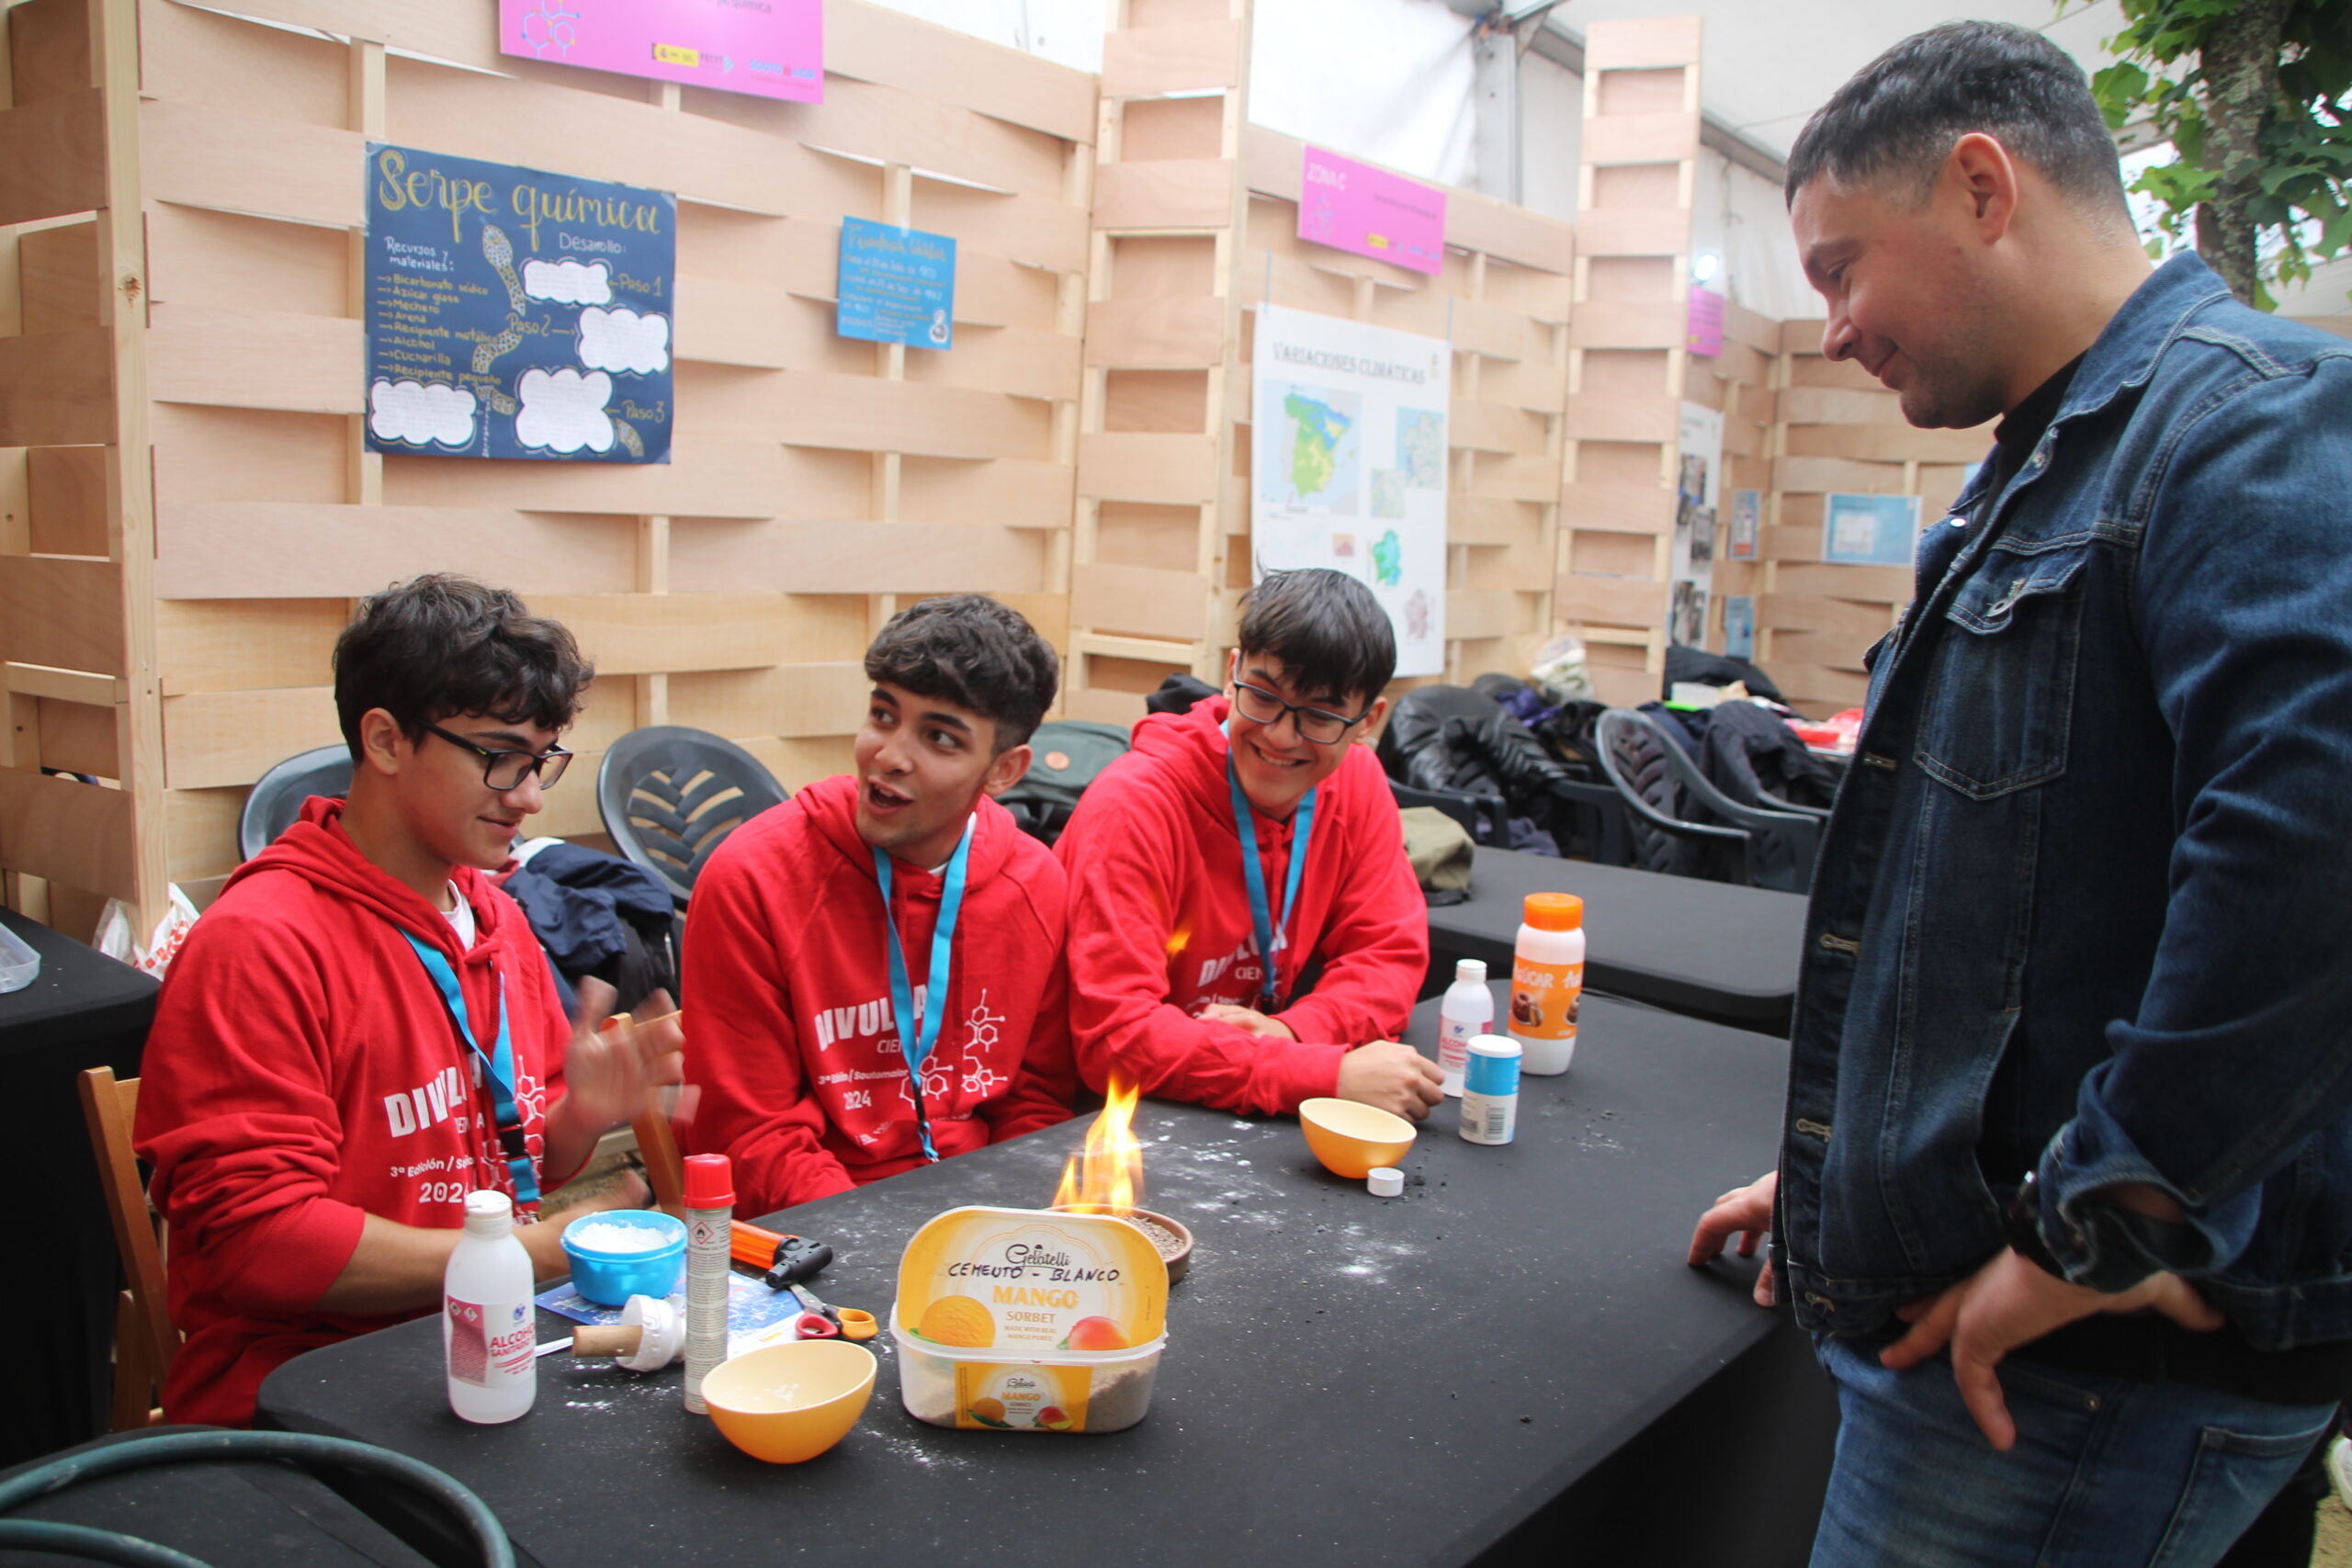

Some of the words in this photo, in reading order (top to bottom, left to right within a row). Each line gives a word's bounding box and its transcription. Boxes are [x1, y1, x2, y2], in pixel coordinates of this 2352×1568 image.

[379, 150, 499, 243] Serpe
[512, 184, 661, 252] química
[384, 236, 436, 257] Recursos
[390, 255, 454, 271] materiales:
[393, 273, 453, 289] Bicarbonato
[653, 276, 662, 297] 1
[393, 299, 440, 314] Mechero
[395, 311, 426, 323] Arena
[393, 321, 449, 338] Recipiente
[394, 349, 451, 366] Cucharilla
[393, 365, 454, 380] Recipiente
[654, 401, 665, 423] 3
[1006, 1243, 1070, 1268] Gelatelli
[1049, 1268, 1120, 1281] BLANCO
[993, 1285, 1079, 1309] MANGO
[1006, 1310, 1057, 1323] SORBET
[1001, 1393, 1041, 1401] MANGO
